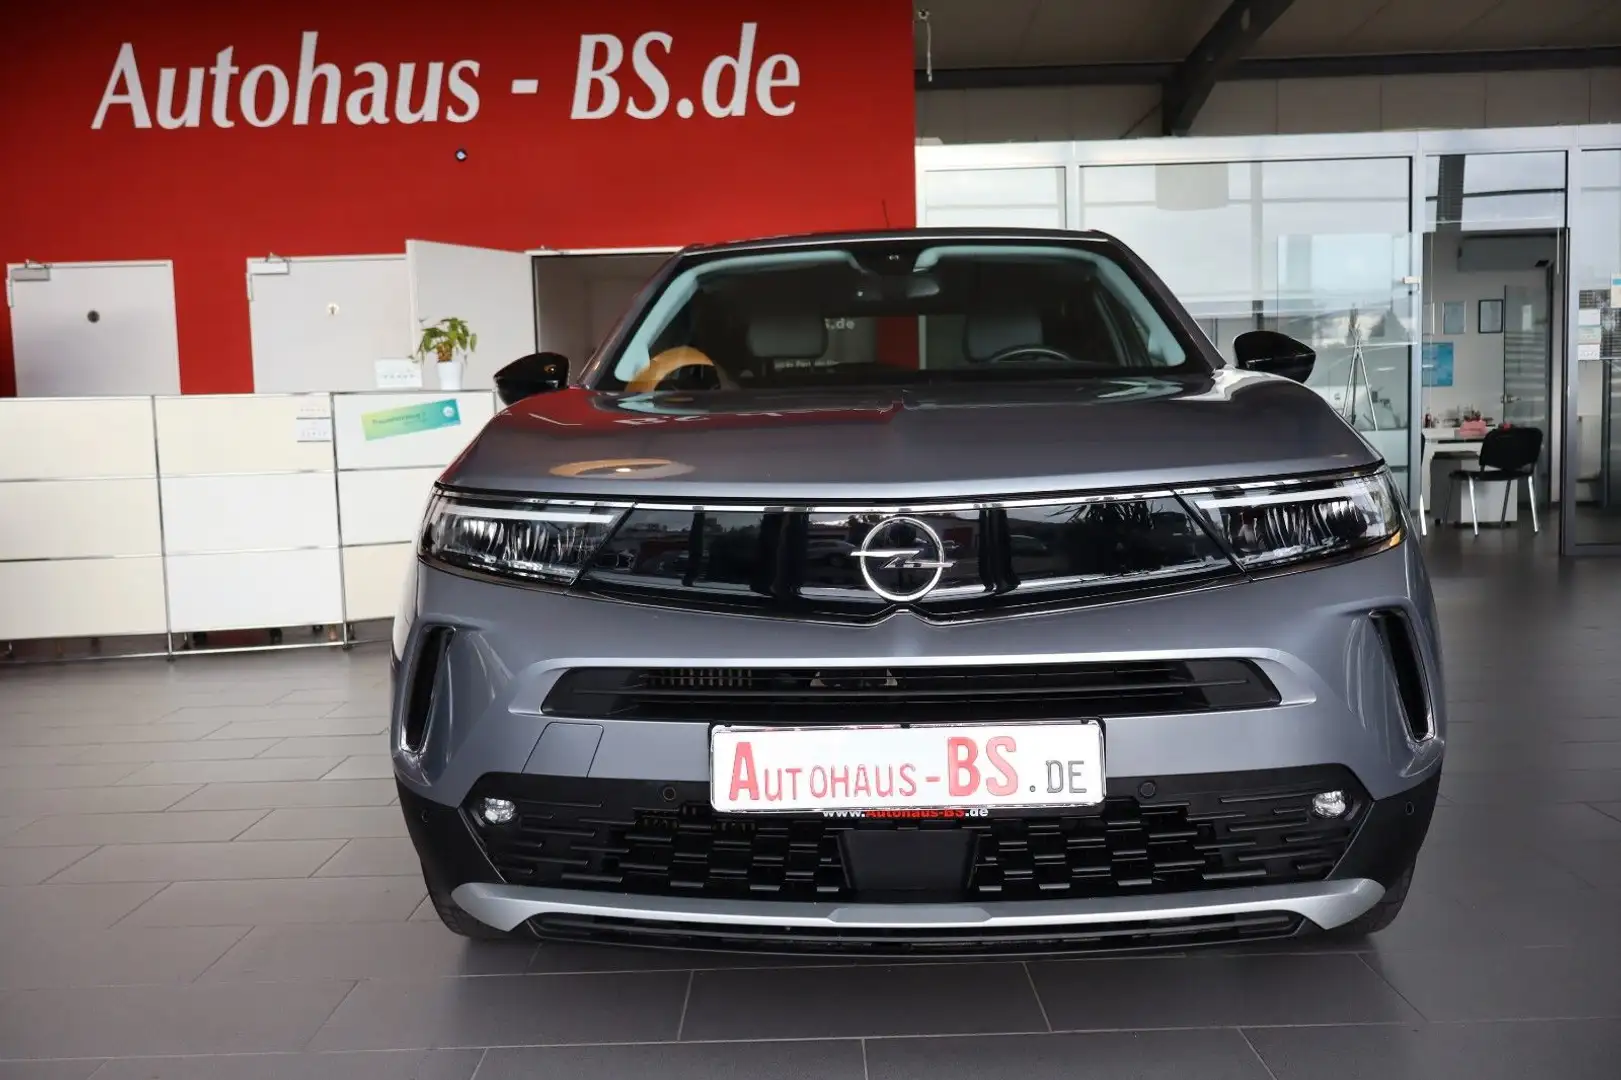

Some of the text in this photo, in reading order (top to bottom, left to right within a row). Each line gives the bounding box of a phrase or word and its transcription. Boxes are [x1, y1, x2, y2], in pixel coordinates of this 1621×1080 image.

[91, 22, 801, 130] Autohaus - BS.de
